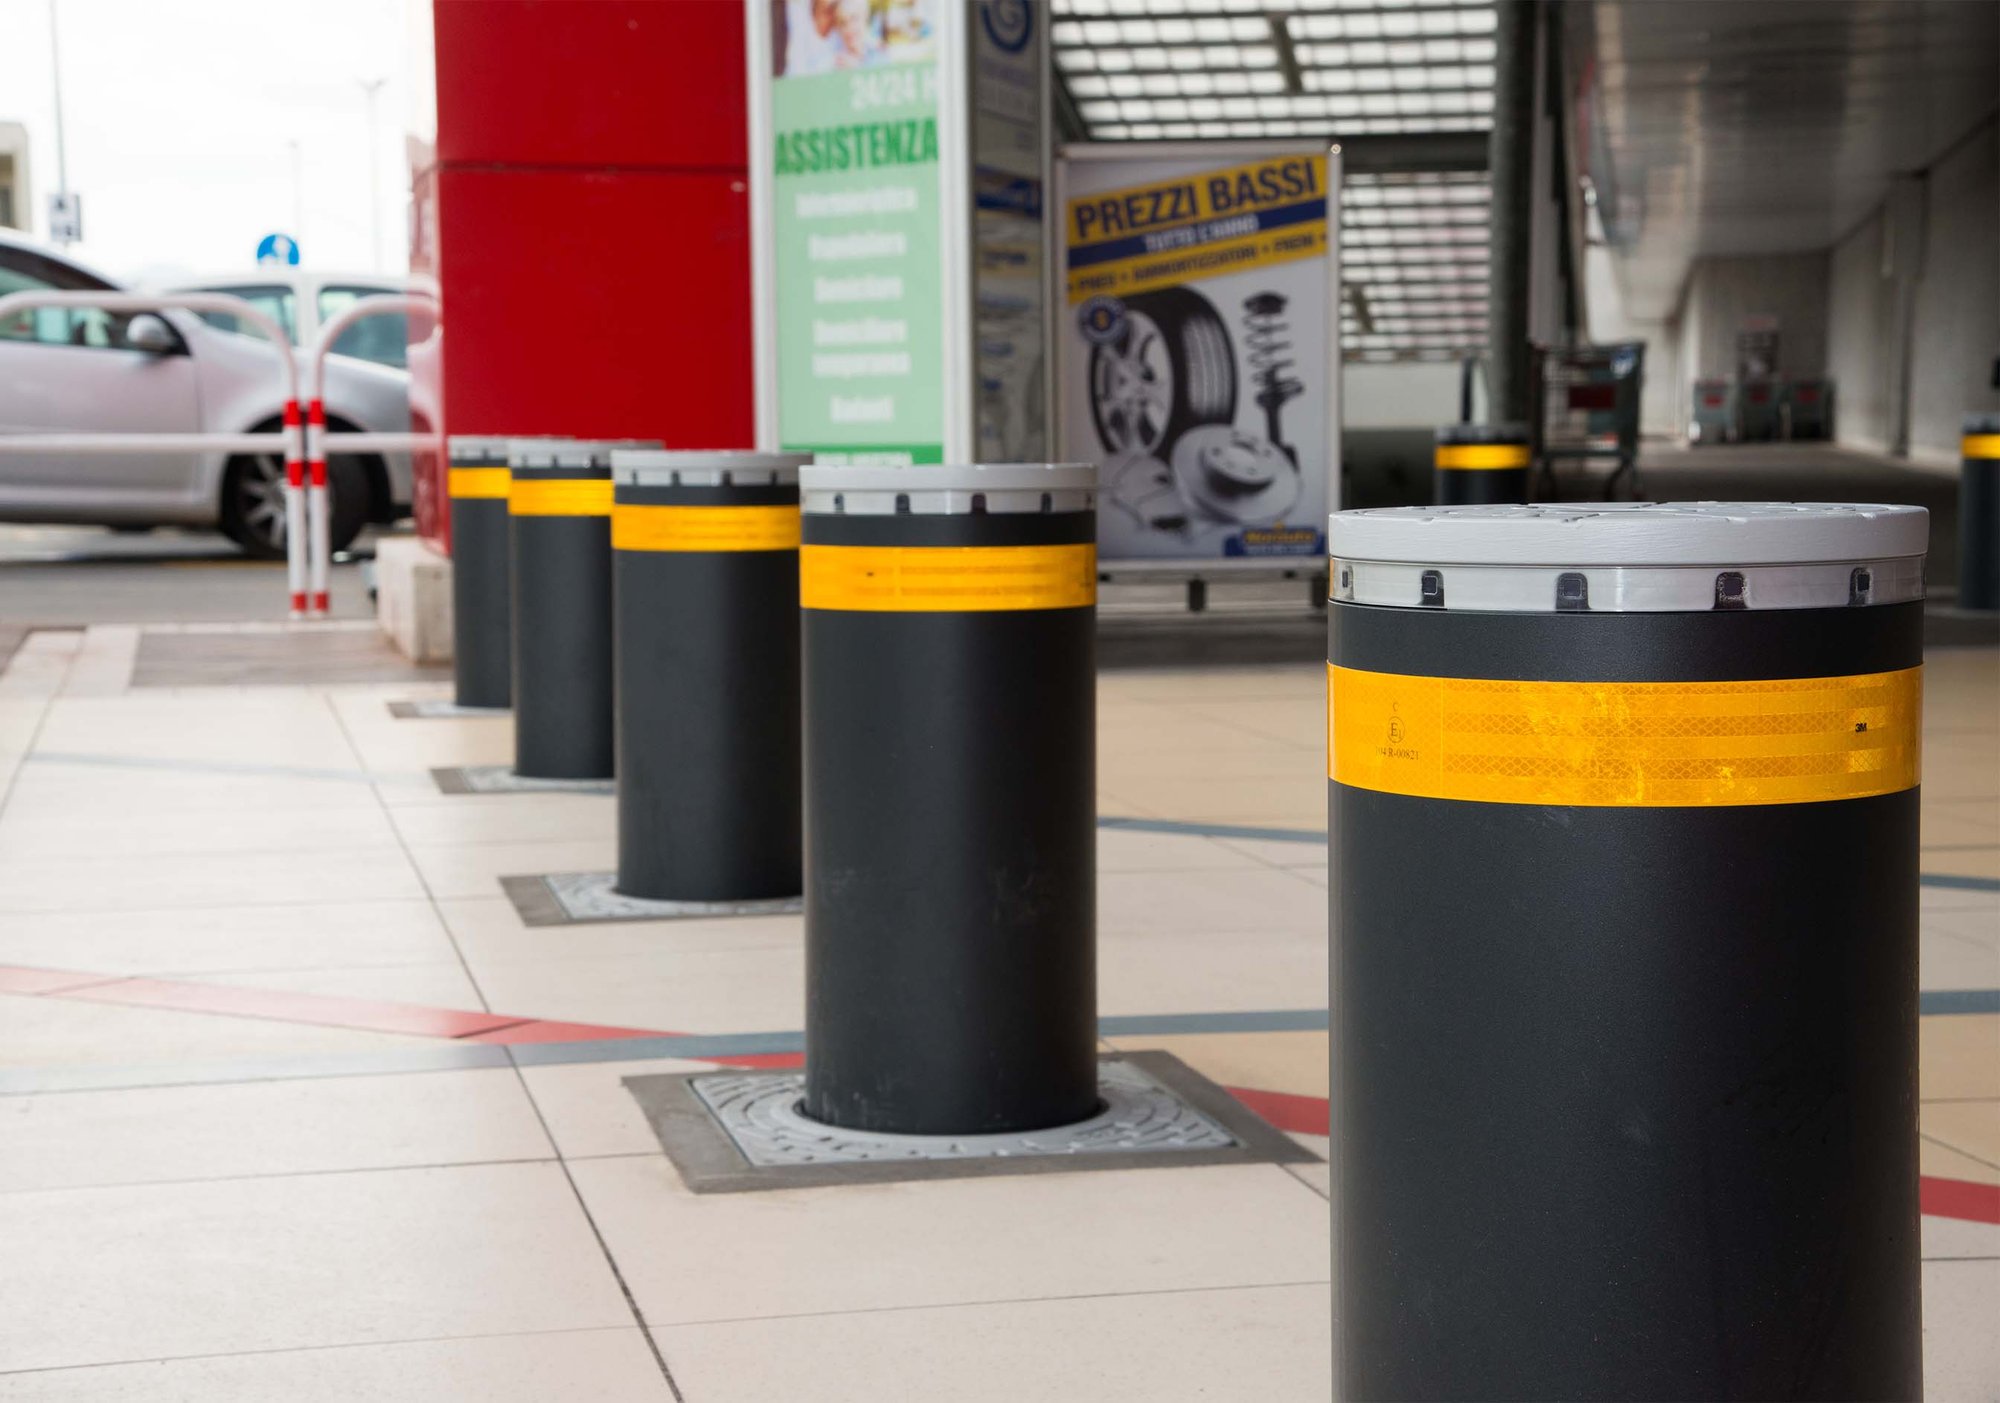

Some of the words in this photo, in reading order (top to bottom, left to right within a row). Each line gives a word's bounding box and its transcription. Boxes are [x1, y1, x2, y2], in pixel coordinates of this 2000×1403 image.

[775, 117, 938, 176] ASSISTENZA
[1075, 185, 1197, 238] PREZZI
[1207, 160, 1317, 212] BASSI
[1855, 723, 1867, 732] 3M
